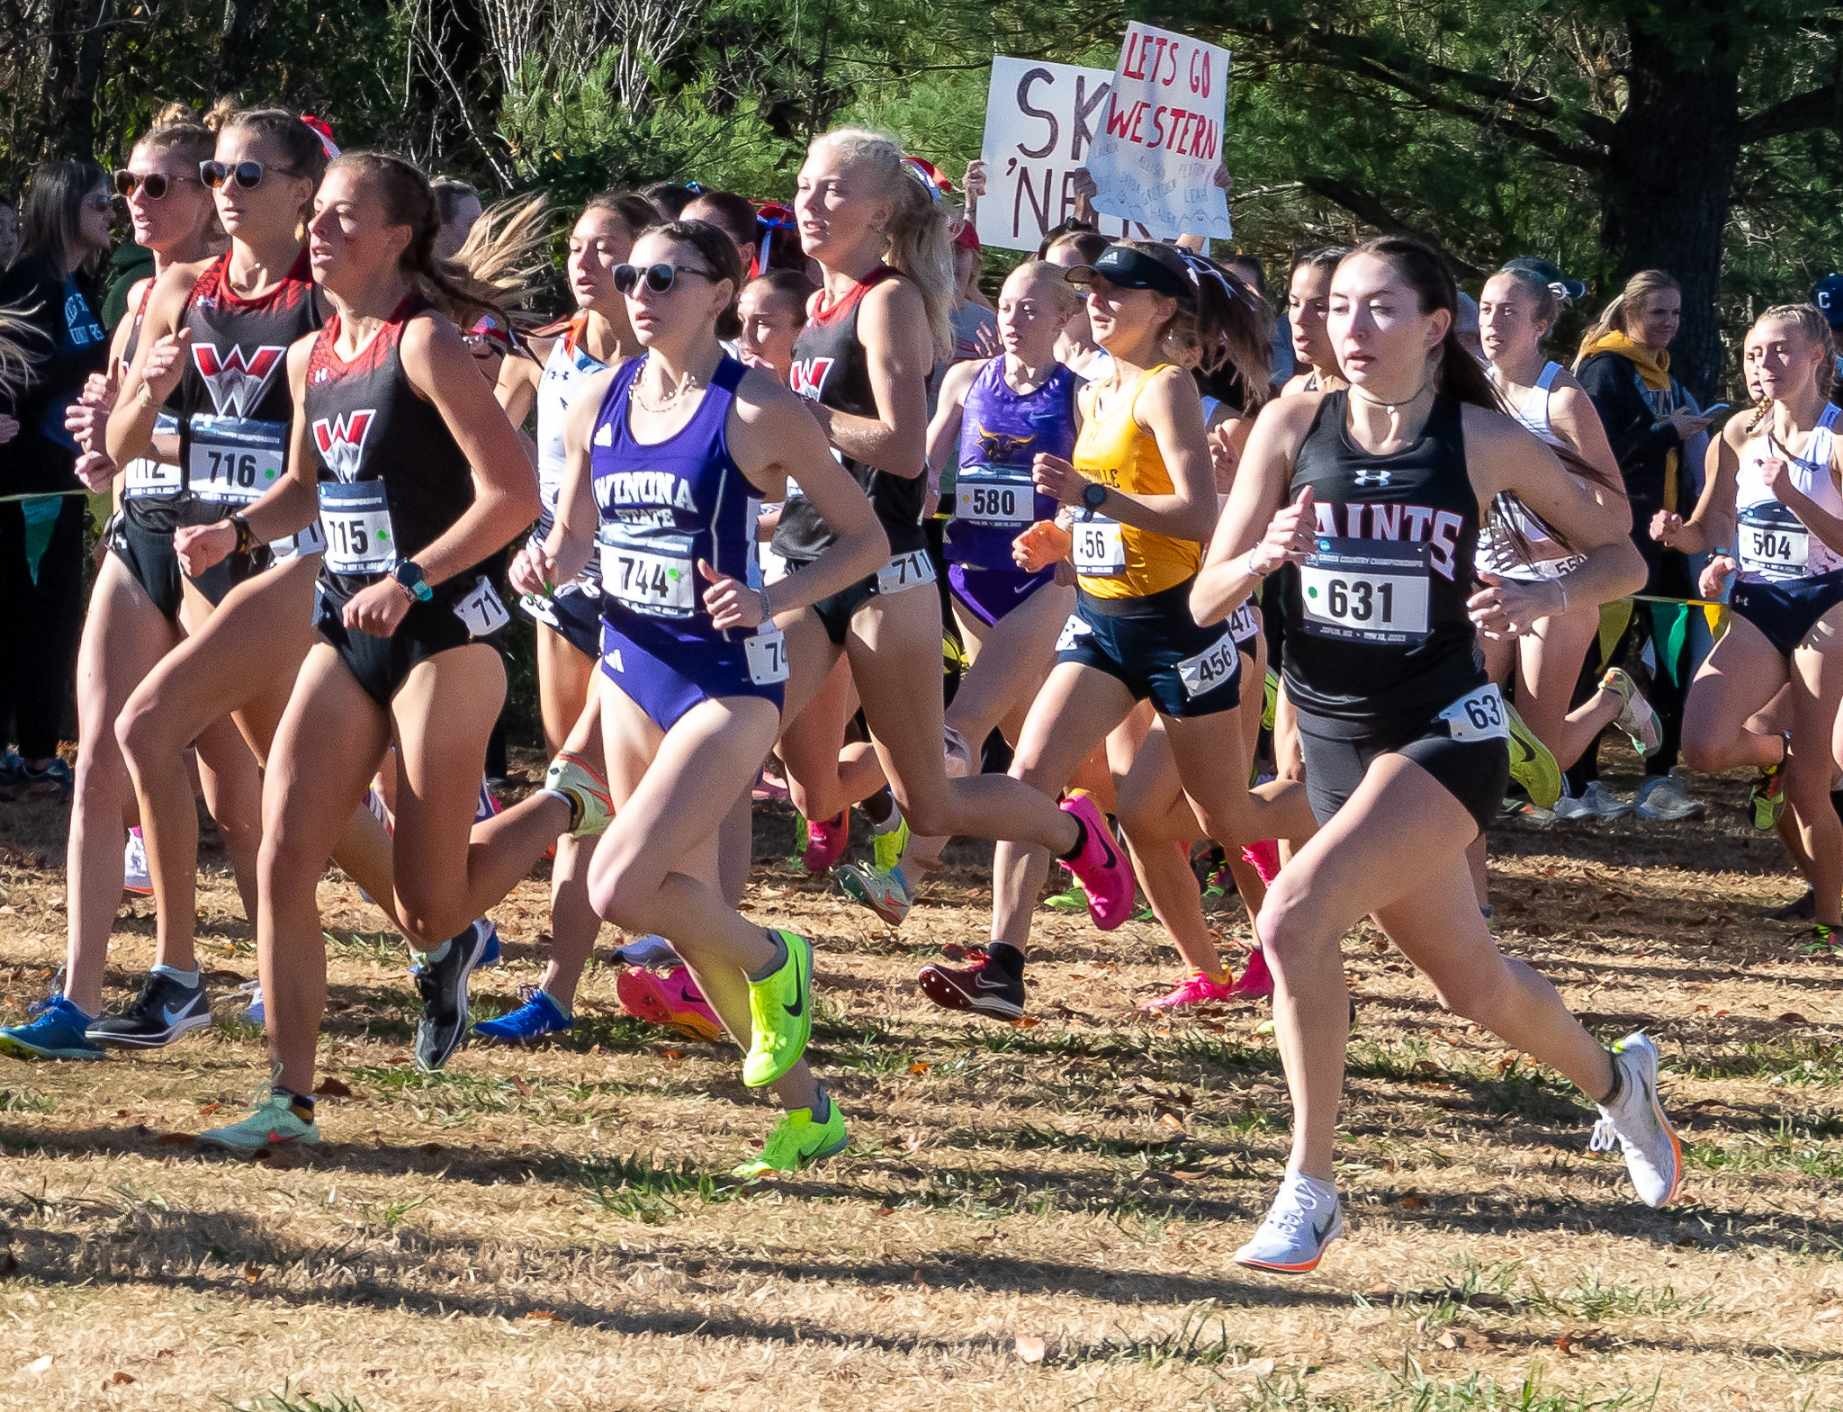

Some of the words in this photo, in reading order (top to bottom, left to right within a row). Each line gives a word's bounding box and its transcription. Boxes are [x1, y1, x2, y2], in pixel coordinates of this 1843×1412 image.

[1122, 31, 1180, 87] LETS
[1189, 46, 1212, 98] GO
[1016, 67, 1112, 162] SK
[1105, 91, 1219, 161] WESTERN
[1816, 290, 1832, 310] C
[208, 451, 257, 489] 716
[594, 470, 699, 514] WINONA
[972, 488, 1015, 516] 580
[1079, 530, 1106, 560] 56
[1312, 502, 1464, 582] AINTS
[1751, 531, 1792, 561] 504
[618, 556, 669, 598] 744
[471, 590, 503, 627] 71
[1230, 606, 1256, 633] 47
[1328, 579, 1393, 623] 631
[1198, 644, 1233, 683] 456
[1463, 694, 1505, 730] 63
